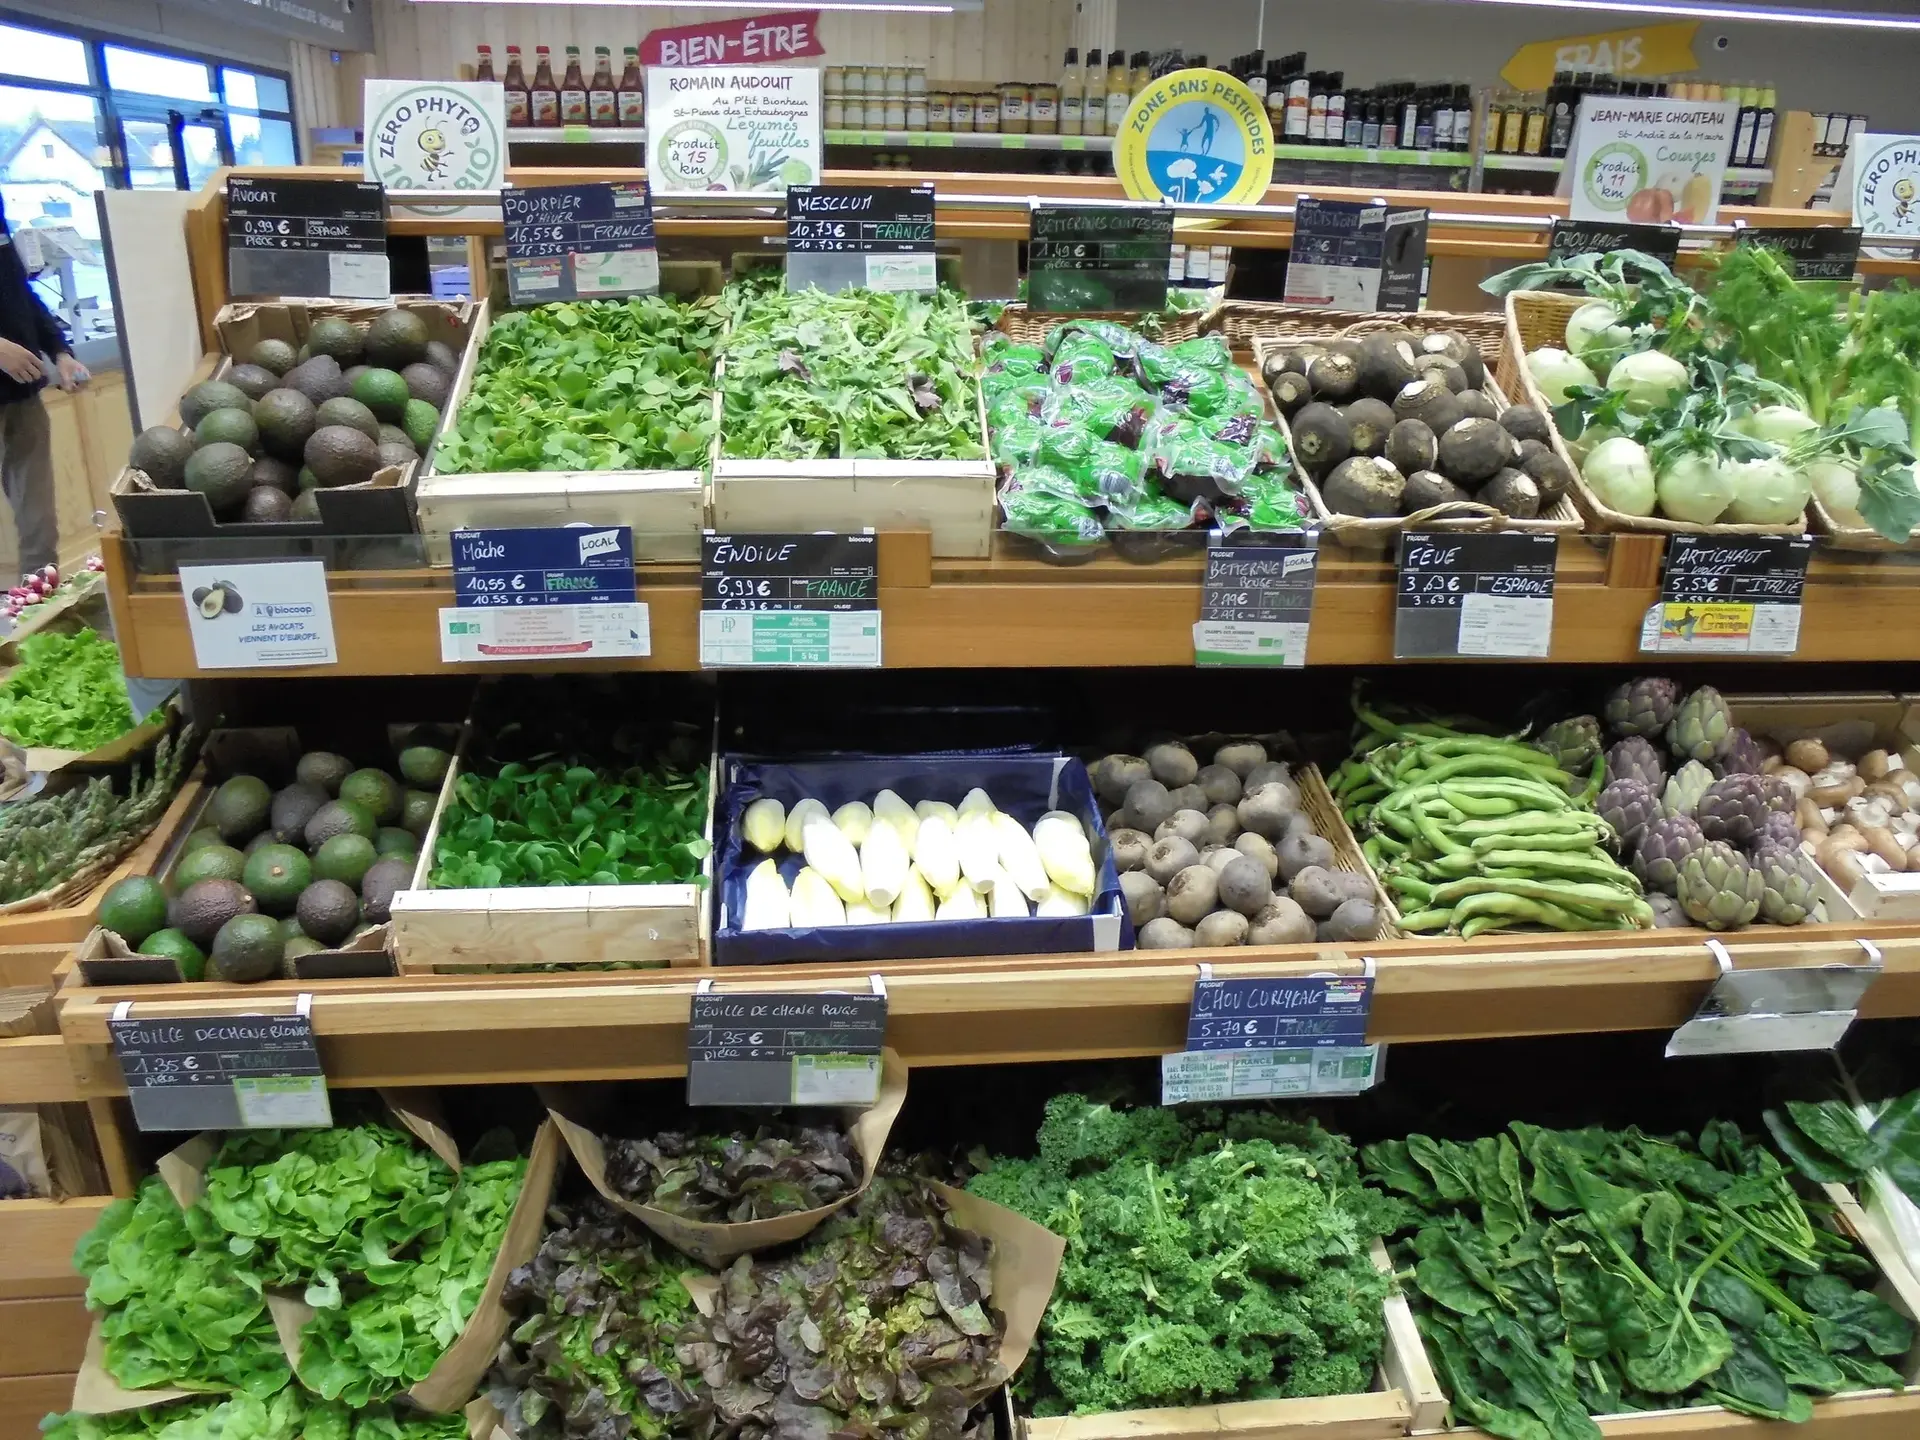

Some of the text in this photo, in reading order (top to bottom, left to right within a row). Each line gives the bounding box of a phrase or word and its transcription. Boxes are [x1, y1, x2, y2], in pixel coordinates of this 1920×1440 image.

[660, 20, 809, 65] BIEN-ÊTRE
[670, 75, 793, 92] ROMAIN AUDOUIT
[712, 97, 729, 106] Au
[734, 96, 757, 106] P'tit
[723, 108, 741, 116] des
[1132, 79, 1265, 155] ZONE SANS PESTICIDES
[1590, 110, 1725, 124] JEAN-MARIE CHOUTEAU
[377, 97, 481, 159] ZÉRO PHYTO
[726, 115, 798, 140] Légumes
[668, 137, 721, 150] Produit
[748, 131, 810, 159] feuilles
[672, 149, 707, 163] à 15
[1656, 146, 1716, 172] Courges
[680, 162, 706, 175] km
[1594, 159, 1641, 174] Produit
[1596, 173, 1626, 186] à 11
[1863, 149, 1920, 207] ZÉRO PH
[232, 187, 277, 203] AVOCAT
[1601, 186, 1625, 199] km
[505, 194, 582, 215] POURPIER
[526, 212, 574, 224] D'HIVER
[277, 219, 290, 235] €
[307, 225, 351, 237] ESPAGNE
[594, 223, 653, 239] FRANCE
[875, 222, 934, 240] FRANCE
[1553, 230, 1628, 248] CHOU RAVE
[462, 541, 505, 561] Mâche
[581, 537, 615, 550] LOCAL
[713, 544, 798, 564] ENDIVE
[1676, 546, 1771, 565] ARTICHAUT
[1209, 560, 1279, 579] BETTERAVE
[1285, 558, 1310, 567] LOCAL
[1690, 564, 1736, 575] VIOLET
[511, 574, 526, 591] €
[547, 576, 599, 590] FRANCE
[806, 577, 870, 598] FRANCE
[1239, 576, 1272, 589] ROUGE
[1491, 576, 1554, 593] ESPAGNE
[1746, 577, 1804, 594] ITALIE
[274, 604, 313, 614] biocoop
[252, 622, 304, 632] LES AVOCATS
[239, 634, 277, 643] VIENNENT
[801, 652, 819, 661] 5 kg
[1198, 989, 1243, 1012] CHOU
[695, 1003, 860, 1018] FEUILLE DE CHENE ROUGE
[1244, 1019, 1258, 1035] €
[1286, 1019, 1339, 1035] FRANCE
[116, 1027, 184, 1046] FEUILLE
[749, 1032, 764, 1045] €
[183, 1055, 199, 1070] €
[1235, 1057, 1271, 1066] FRANCE
